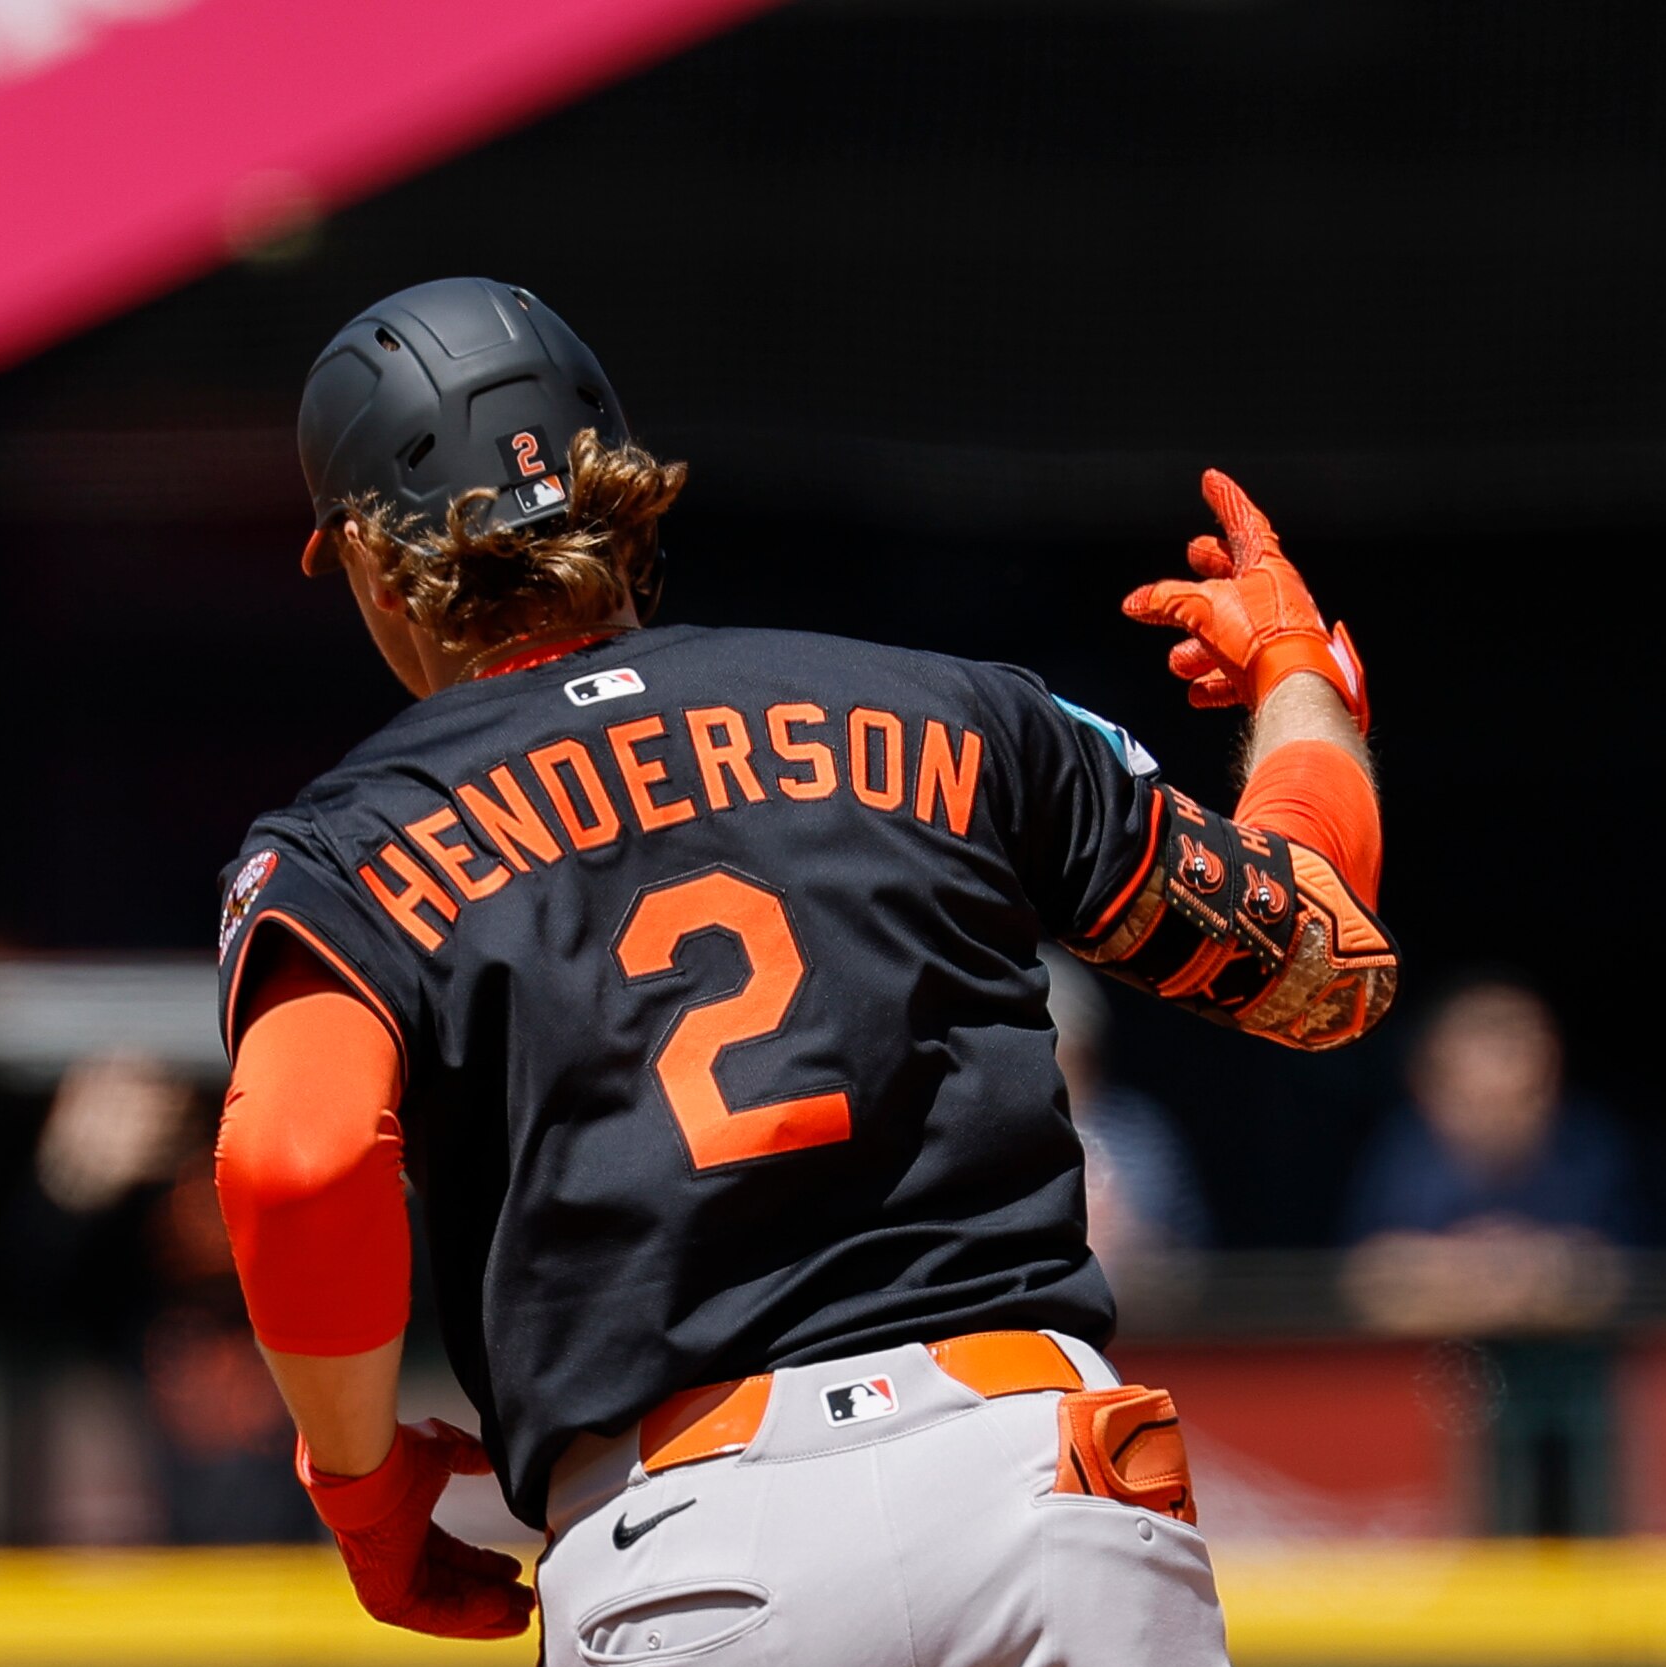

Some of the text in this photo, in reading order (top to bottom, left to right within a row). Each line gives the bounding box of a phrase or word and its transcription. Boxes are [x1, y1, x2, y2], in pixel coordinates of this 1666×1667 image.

[510, 430, 546, 477] 2
[357, 700, 985, 955] HENDERSON
[610, 864, 853, 1175] 2
